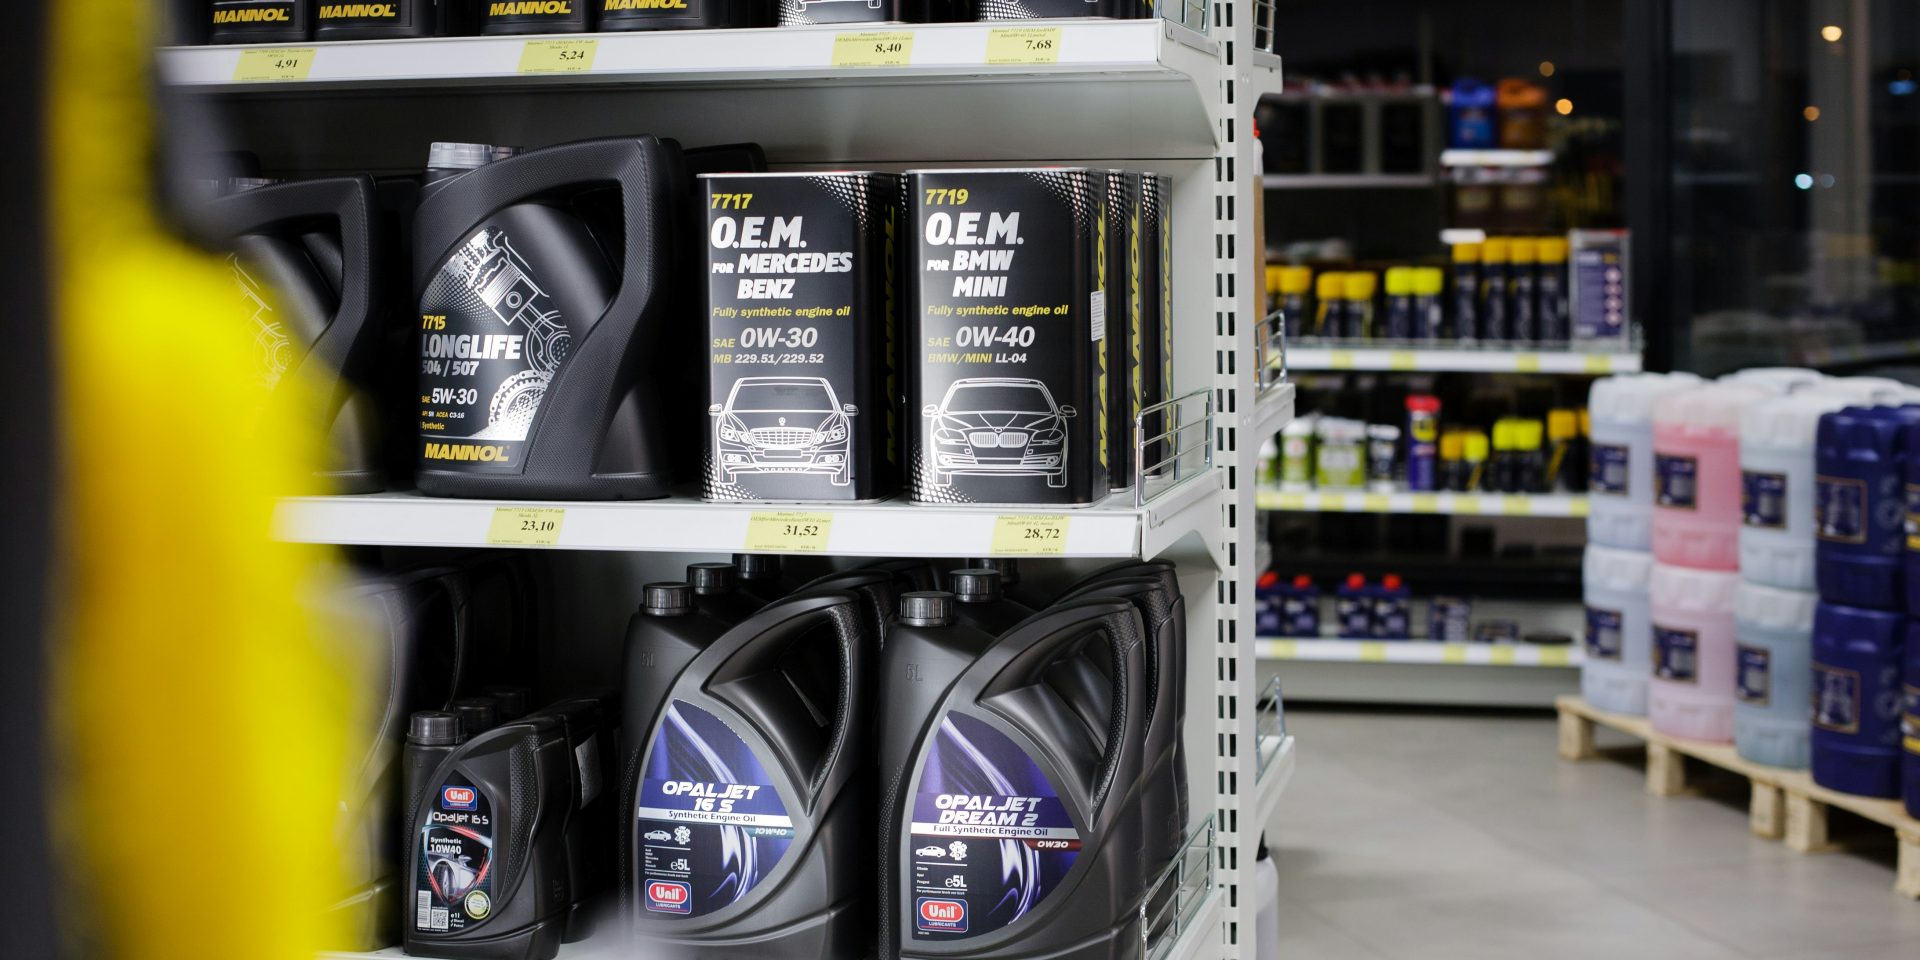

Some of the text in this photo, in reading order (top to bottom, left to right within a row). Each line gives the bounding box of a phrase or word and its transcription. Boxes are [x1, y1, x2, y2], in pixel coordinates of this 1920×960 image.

[320, 4, 396, 19] MANNOL
[490, 1, 571, 17] MANNOL
[605, 0, 687, 11] MANNOL
[214, 8, 290, 24] MANNOL
[875, 43, 902, 53] 8,40
[1025, 40, 1052, 50] 7,68
[559, 50, 585, 60] 5,24
[275, 59, 298, 69] 4,91
[711, 193, 753, 210] 7717
[925, 188, 969, 205] 7719
[710, 216, 807, 249] O.E.M.
[925, 211, 1024, 245] O.E.M.
[712, 252, 853, 274] FOR MERCEDES
[926, 250, 1015, 271] FOR BMW
[737, 278, 796, 299] BENZ
[952, 276, 1008, 297] MINI
[712, 306, 851, 318] Fully synthetic engine oil
[927, 304, 1068, 317] Fully synthetic engine oil
[422, 315, 446, 330] 7715
[712, 327, 818, 348] SAE 0W-30
[927, 326, 1035, 347] SAE 0W-40
[421, 334, 523, 359] LONGLIFE
[713, 354, 824, 365] MB 229.51/229.52
[927, 353, 1027, 364] BMW/MINI LL-04
[421, 361, 442, 375] 504
[452, 361, 479, 376] 507
[431, 387, 478, 405] 5W-30
[435, 411, 449, 419] ACEA
[421, 421, 445, 431] Synthetic
[424, 442, 510, 462] MANNOL
[521, 520, 555, 532] 23,10
[783, 525, 818, 536] 31,52
[1024, 528, 1060, 540] 28,72
[450, 790, 468, 801] Unil
[662, 781, 760, 800] OPALJET
[694, 798, 735, 813] 16 S
[935, 794, 1042, 812] OPALJET
[432, 812, 468, 824] Opaljet
[668, 810, 709, 820] Synthetic
[710, 813, 741, 822] Engine
[938, 810, 1039, 827] DREAM 2
[933, 824, 1048, 836] Full Synthetic Engine Oil
[430, 836, 462, 845] Synthetic
[430, 844, 462, 855] 10W40
[655, 886, 679, 901] Unil
[928, 904, 955, 919] Unil
